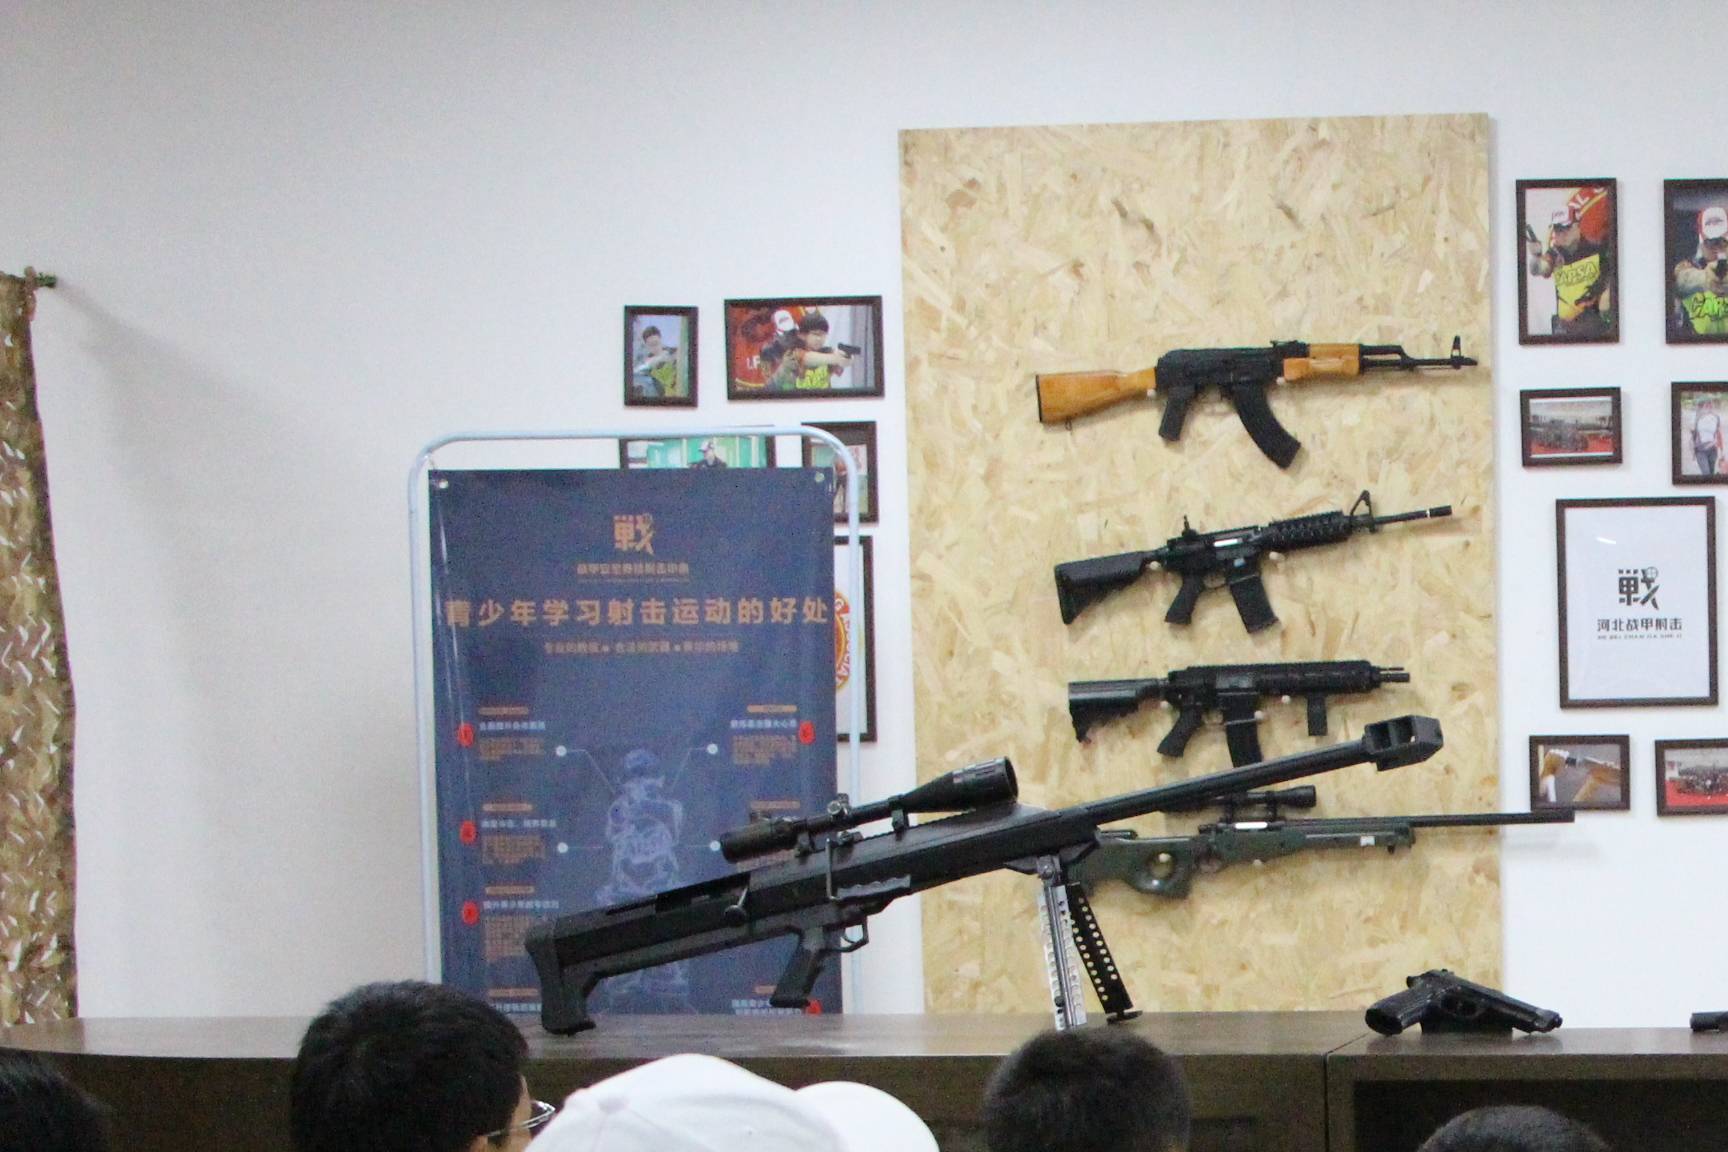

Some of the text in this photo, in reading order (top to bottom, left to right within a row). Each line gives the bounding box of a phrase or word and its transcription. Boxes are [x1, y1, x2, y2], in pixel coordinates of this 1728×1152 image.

[445, 597, 828, 627] 青少年学习射击运动的好处
[1597, 618, 1682, 632] 河北战甲射击
